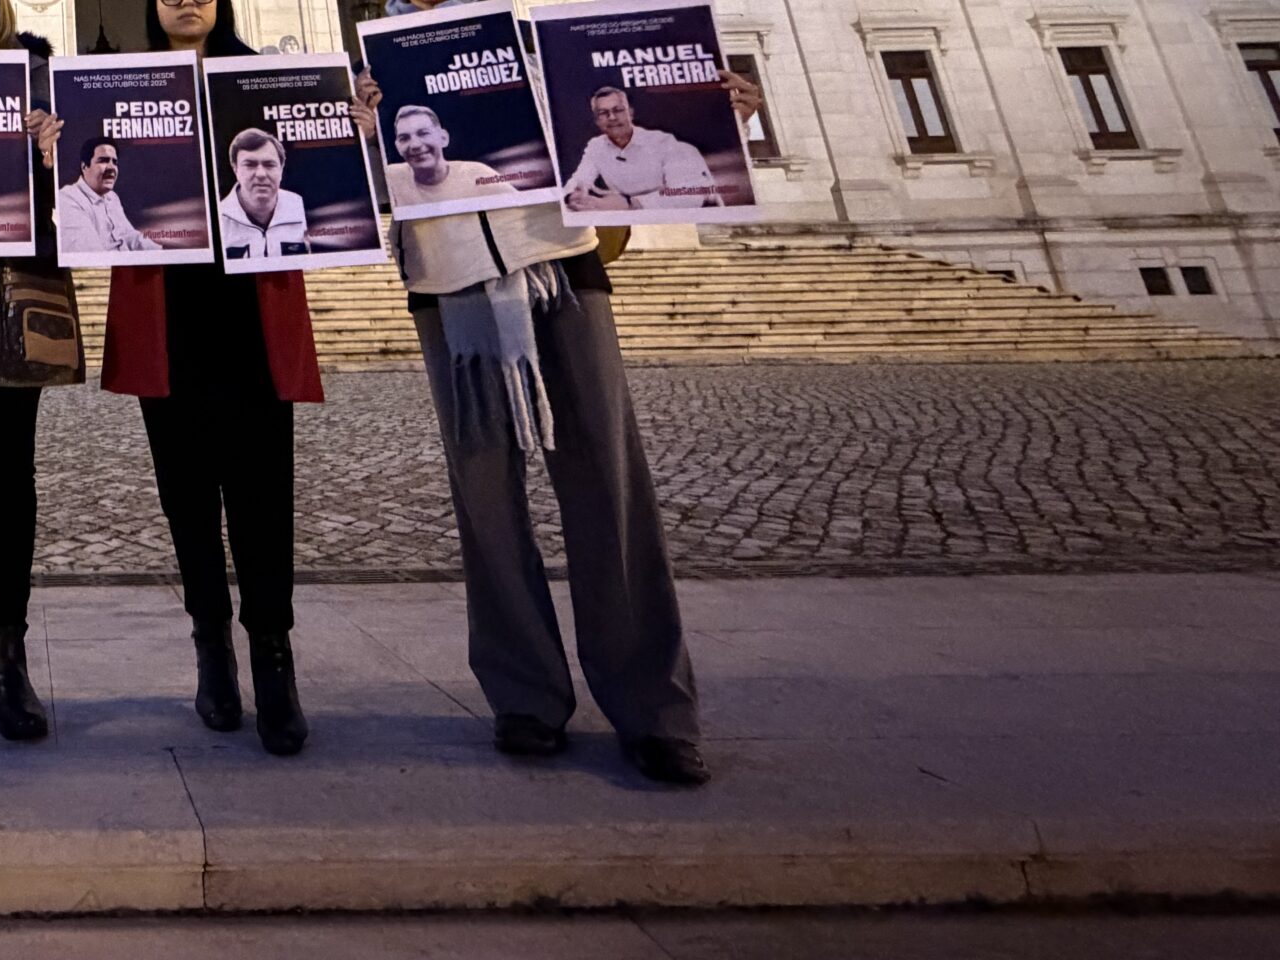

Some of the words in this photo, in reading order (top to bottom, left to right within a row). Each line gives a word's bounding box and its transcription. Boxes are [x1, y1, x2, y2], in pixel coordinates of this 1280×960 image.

[426, 31, 435, 39] DO
[448, 46, 515, 70] JUAN
[591, 43, 714, 68] MANUEL
[424, 61, 523, 95] RODRIGUEZ
[621, 60, 721, 88] FERREIRA
[115, 100, 191, 117] PEDRO
[263, 101, 349, 120] HECTOR
[103, 116, 194, 139] FERNANDEZ
[276, 117, 354, 142] FERREIRA
